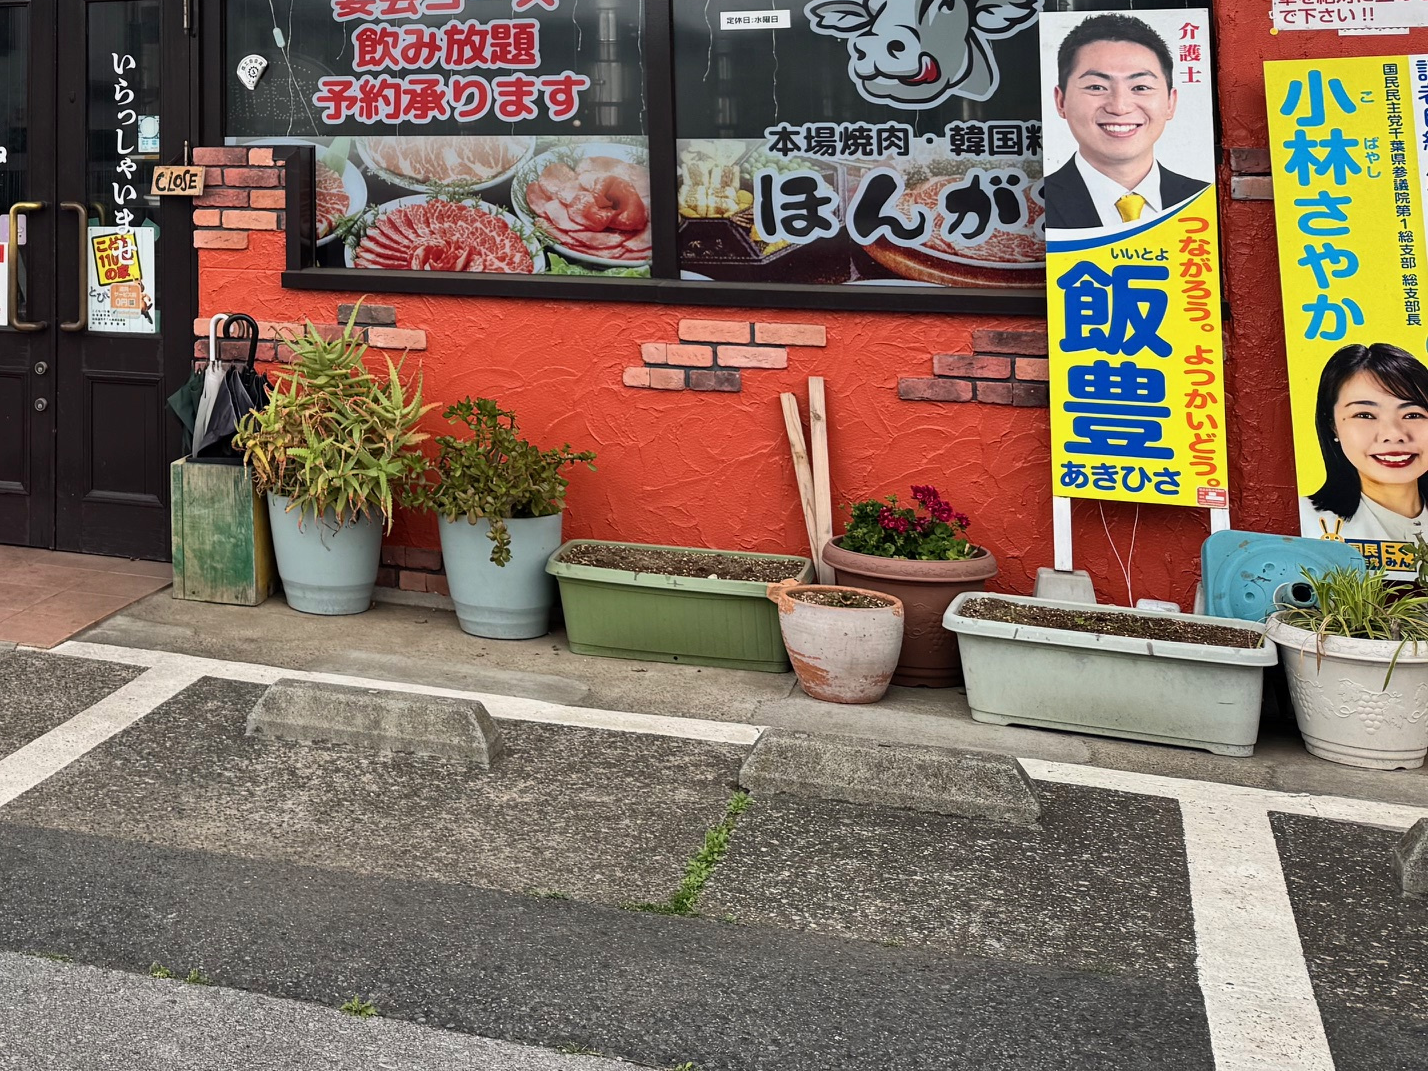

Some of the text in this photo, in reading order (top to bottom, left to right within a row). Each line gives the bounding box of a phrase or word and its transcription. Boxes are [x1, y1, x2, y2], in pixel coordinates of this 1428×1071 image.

[354, 19, 540, 71] 飲み放題
[1178, 21, 1203, 85] 介護士
[315, 72, 588, 123] 予約承ります
[1360, 90, 1375, 104] こ
[111, 52, 138, 265] いらっしゃいませ
[155, 169, 198, 192] CLOSE
[1363, 136, 1382, 179] ばやし
[759, 172, 1045, 240] ほんが
[1279, 69, 1365, 342] 小林さやか
[1109, 246, 1170, 262] いいとよ
[1177, 215, 1215, 333] つながろう。
[1401, 273, 1422, 326] 総支部長
[1056, 259, 1174, 461] 飯豊
[1182, 343, 1222, 488] よつかいどう。
[1059, 460, 1182, 496] あきひさ
